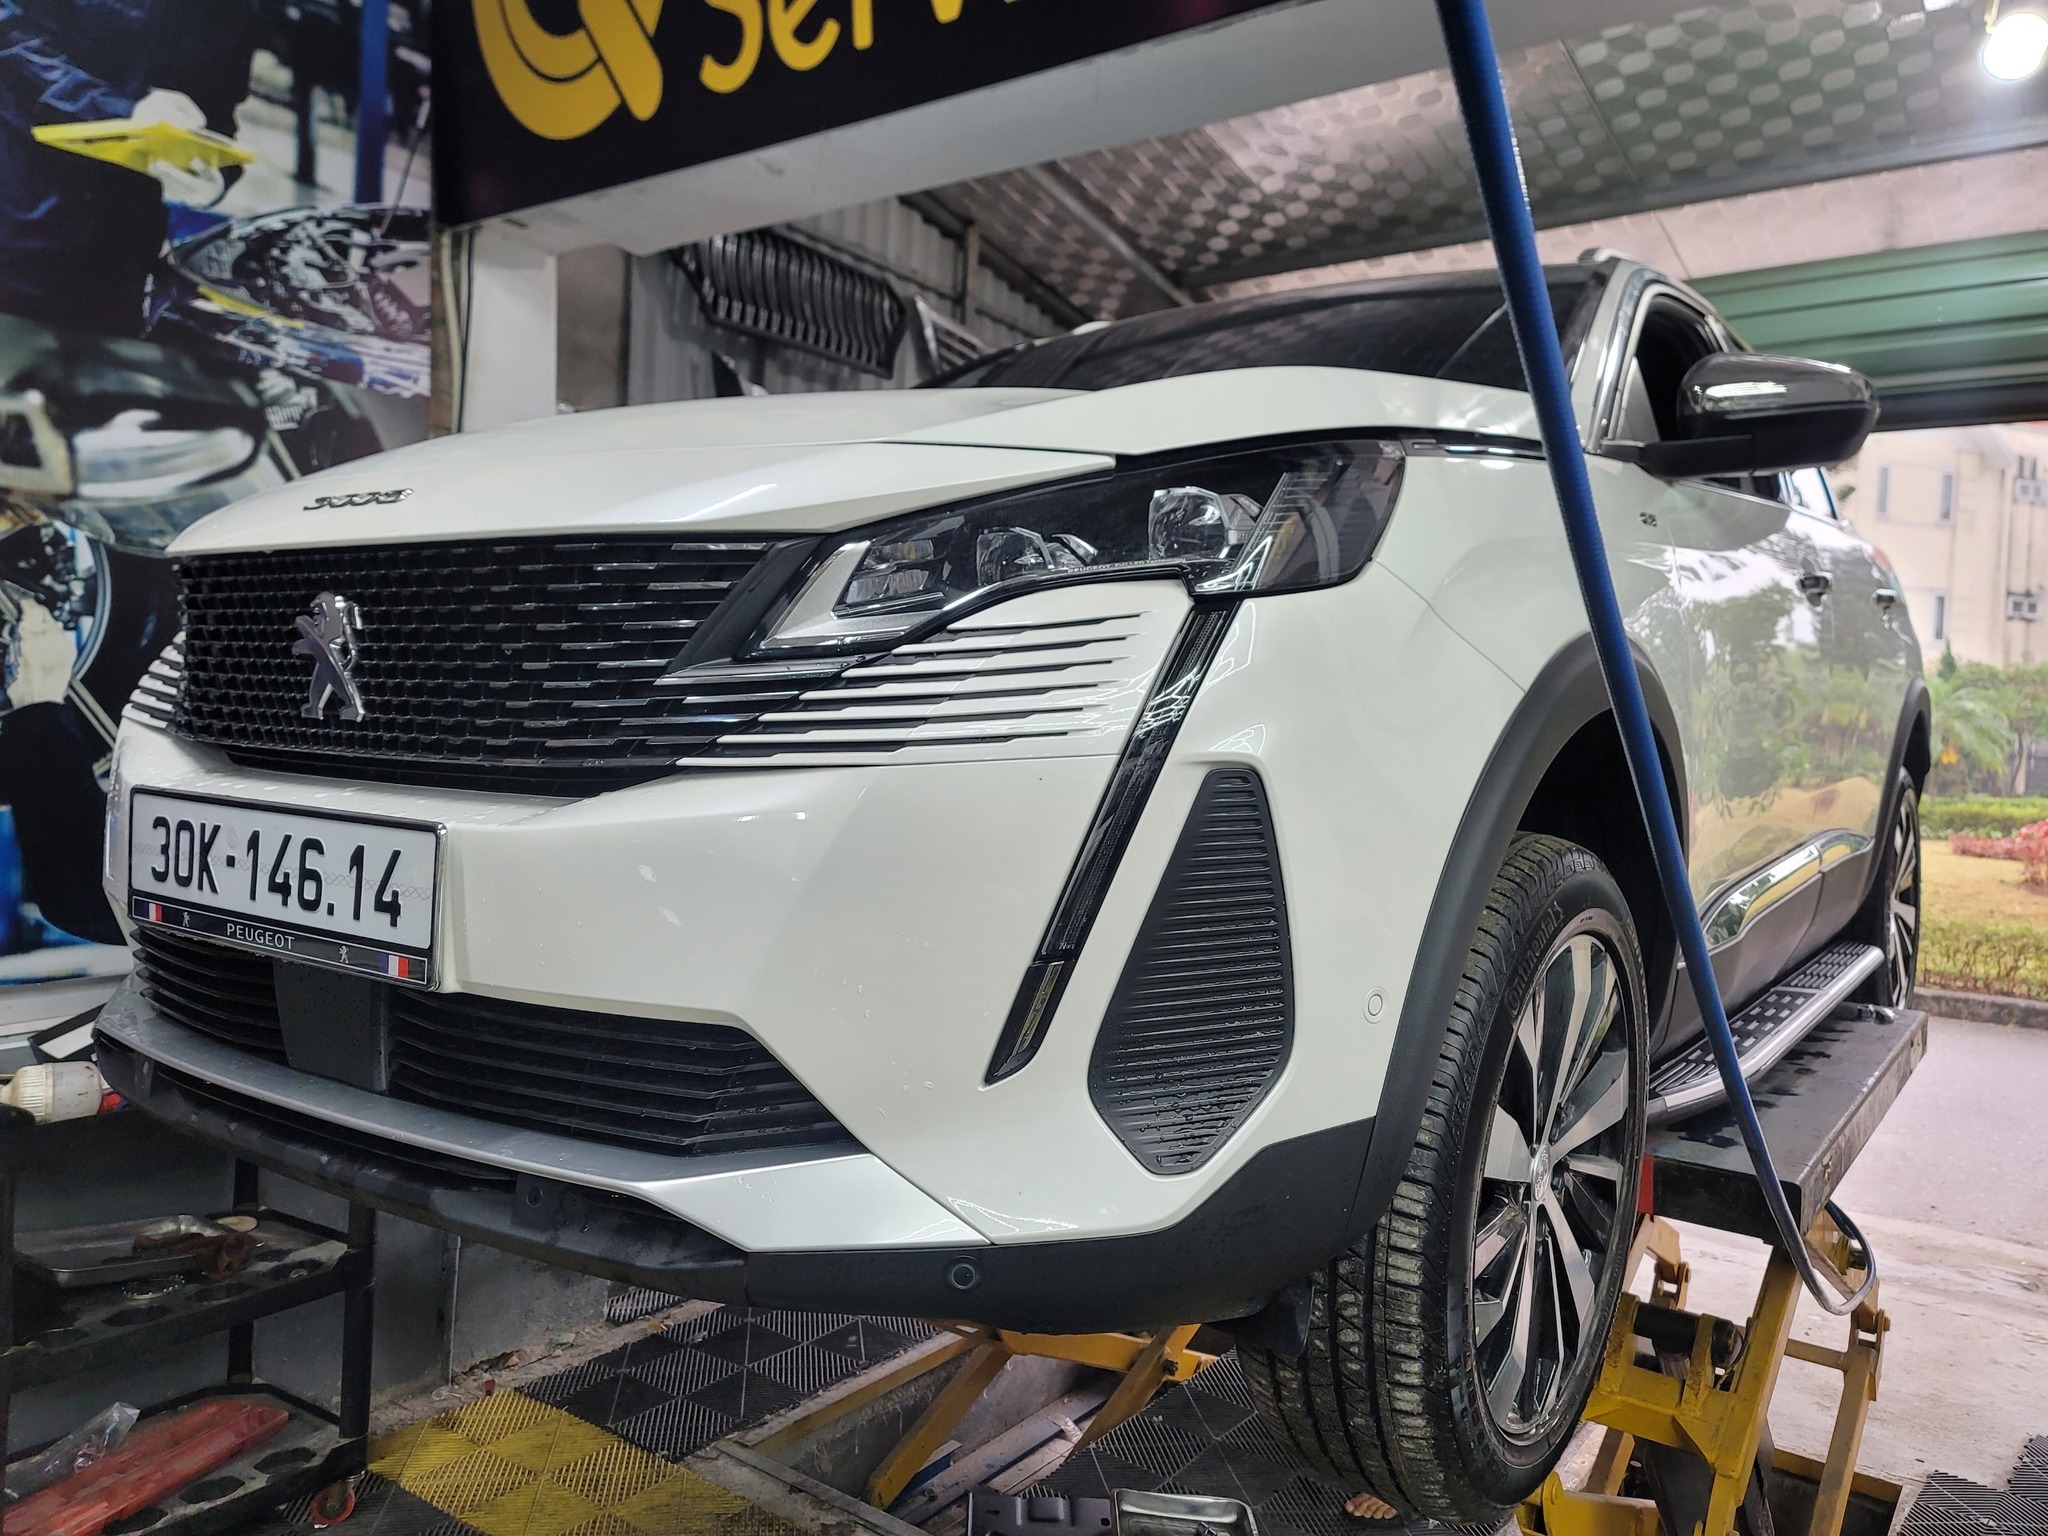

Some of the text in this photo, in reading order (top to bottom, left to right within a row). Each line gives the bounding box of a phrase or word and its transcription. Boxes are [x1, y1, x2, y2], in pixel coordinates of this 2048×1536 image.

[1067, 564, 1111, 573] PEUGEOT
[151, 816, 401, 928] 30K-146.14
[226, 922, 295, 950] PEUGEOT
[1504, 907, 1560, 1018] Continental
